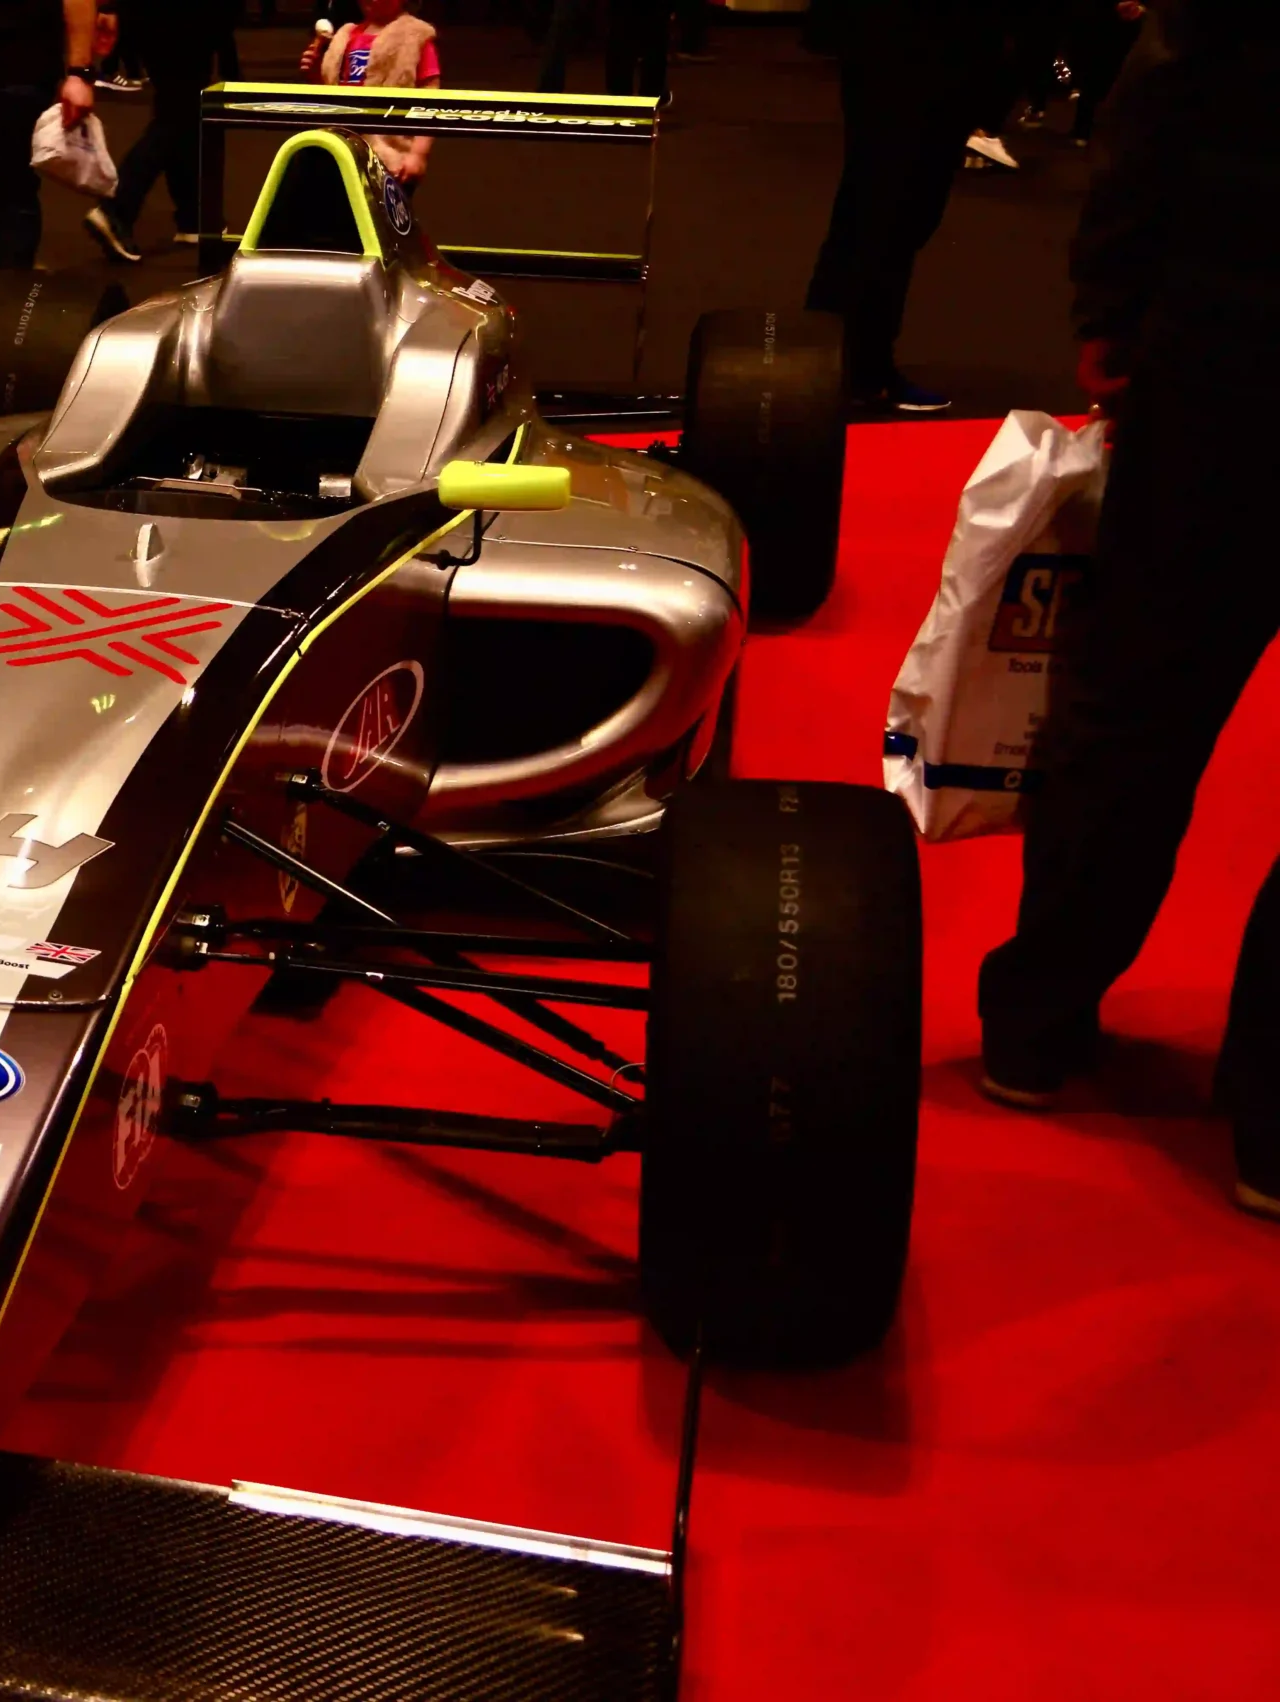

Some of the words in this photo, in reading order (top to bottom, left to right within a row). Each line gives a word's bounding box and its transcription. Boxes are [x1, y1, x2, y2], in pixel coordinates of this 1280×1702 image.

[404, 111, 637, 127] EcoBoost
[410, 106, 512, 118] Powered
[516, 110, 544, 119] by
[1007, 657, 1043, 673] Tools
[775, 842, 802, 1005] 180/550R13
[115, 1035, 166, 1176] FIA
